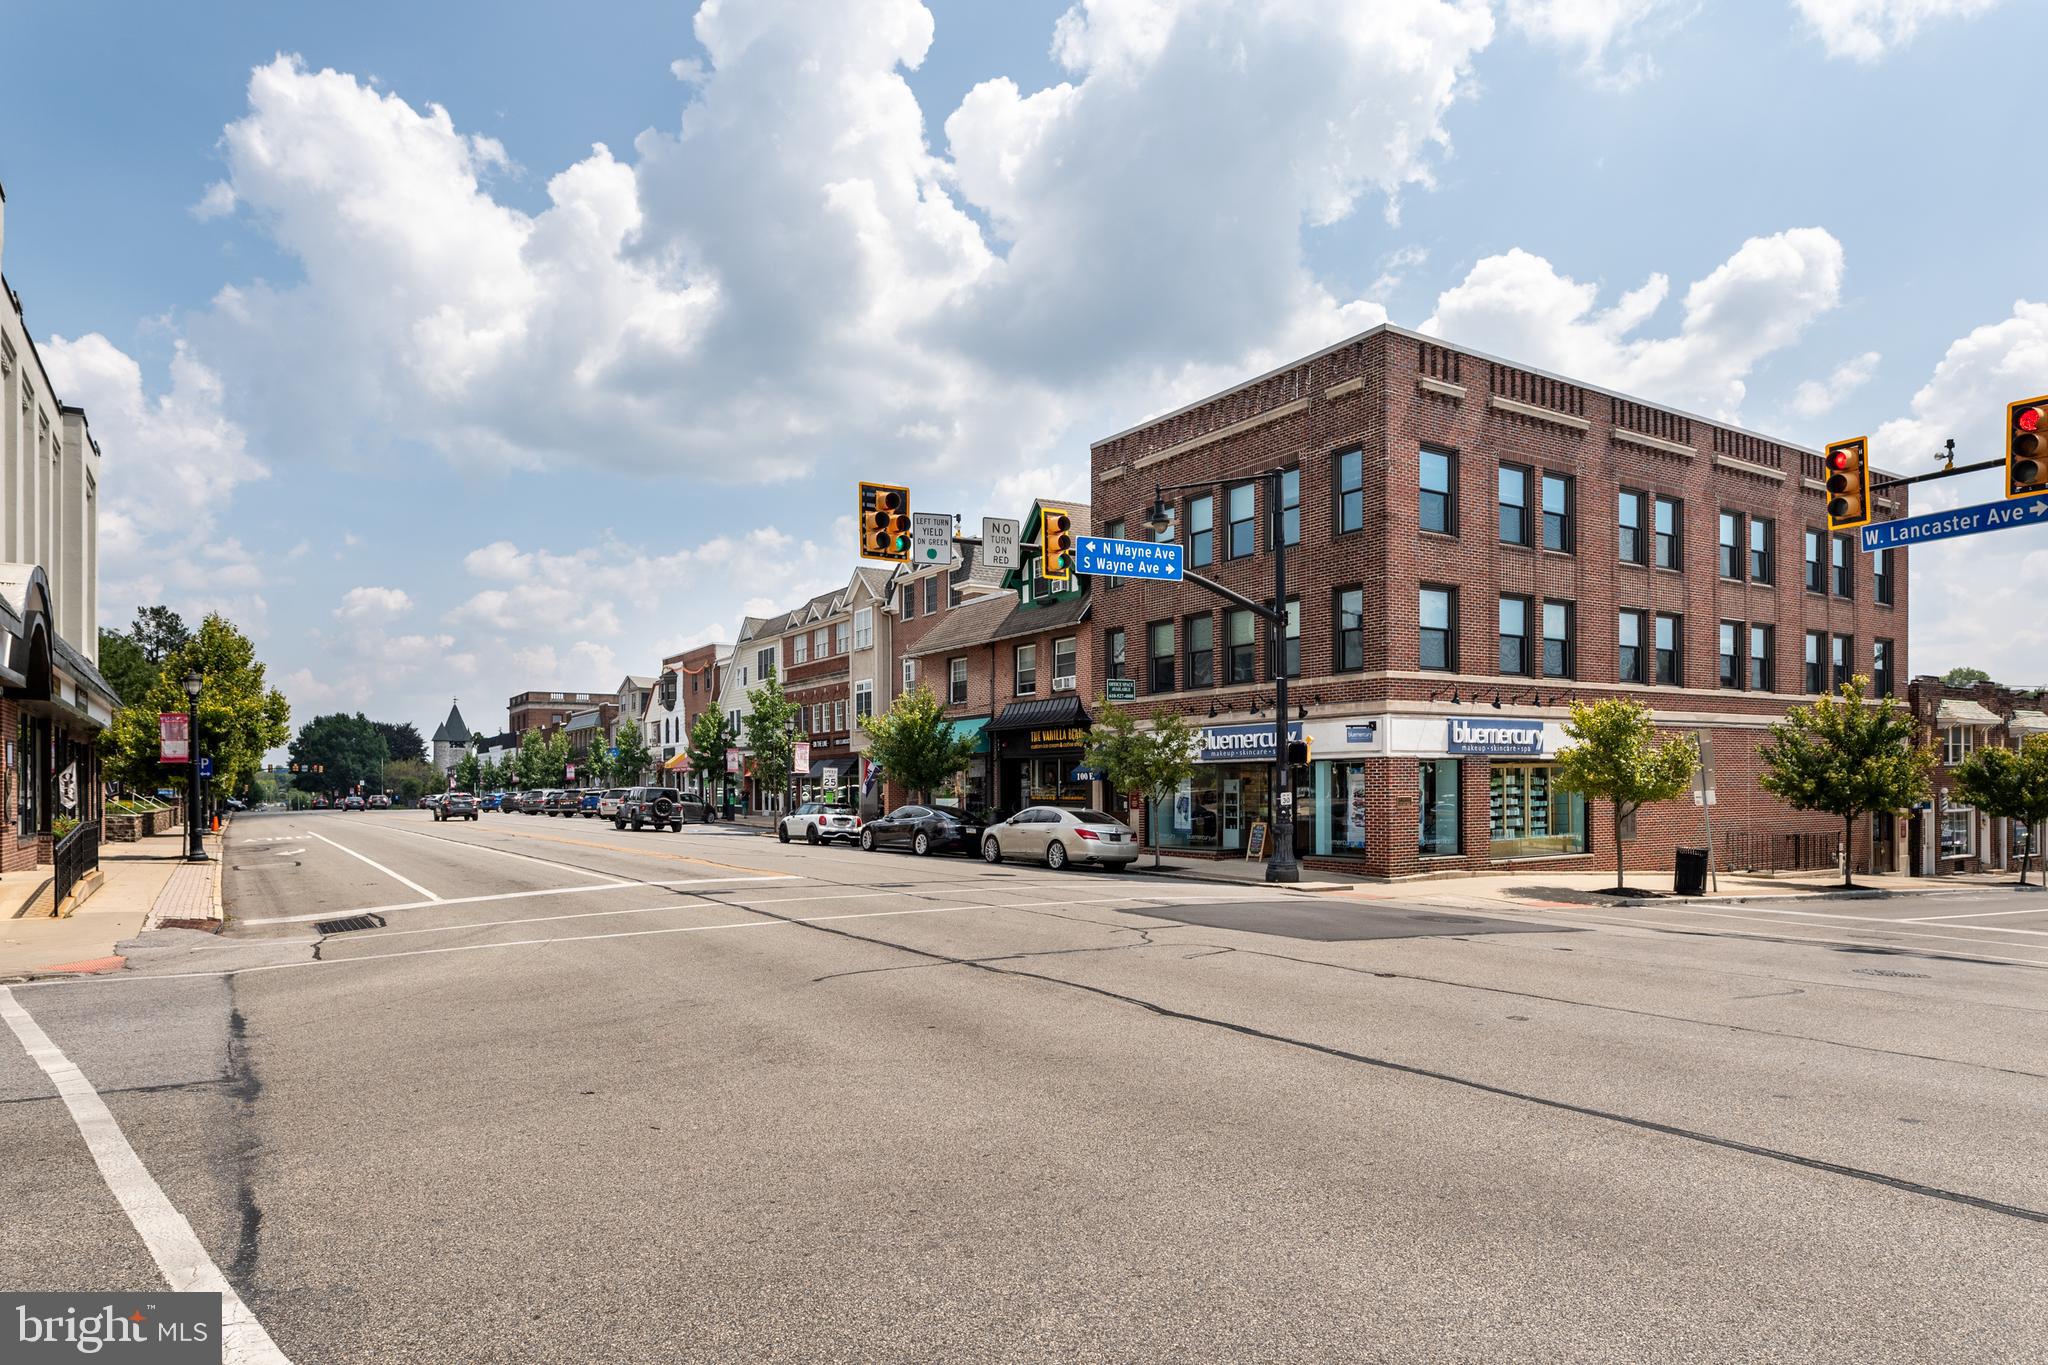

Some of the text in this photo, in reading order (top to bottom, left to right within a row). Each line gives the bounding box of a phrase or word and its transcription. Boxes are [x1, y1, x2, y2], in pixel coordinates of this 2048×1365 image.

[916, 517, 931, 525] LEFT
[1865, 506, 2024, 546] W. Lancaster Ave
[922, 527, 943, 536] YIELD
[992, 523, 1011, 534] NO
[928, 538, 948, 546] GREEN
[991, 535, 1012, 544] TURN
[995, 546, 1007, 554] ON
[1103, 542, 1175, 560] N Wayne Ave
[993, 555, 1009, 564] RED
[1083, 556, 1160, 574] S Wayne Ave
[1030, 730, 1041, 742] THE
[1042, 728, 1067, 741] VANILLA
[1199, 730, 1297, 750] bluemercuy
[1453, 720, 1544, 750] bluemercury
[1210, 750, 1235, 758] makeup
[1239, 748, 1268, 756] skincare
[1461, 744, 1531, 753] makeup skincare spa
[201, 758, 209, 769] P
[824, 778, 836, 786] 25
